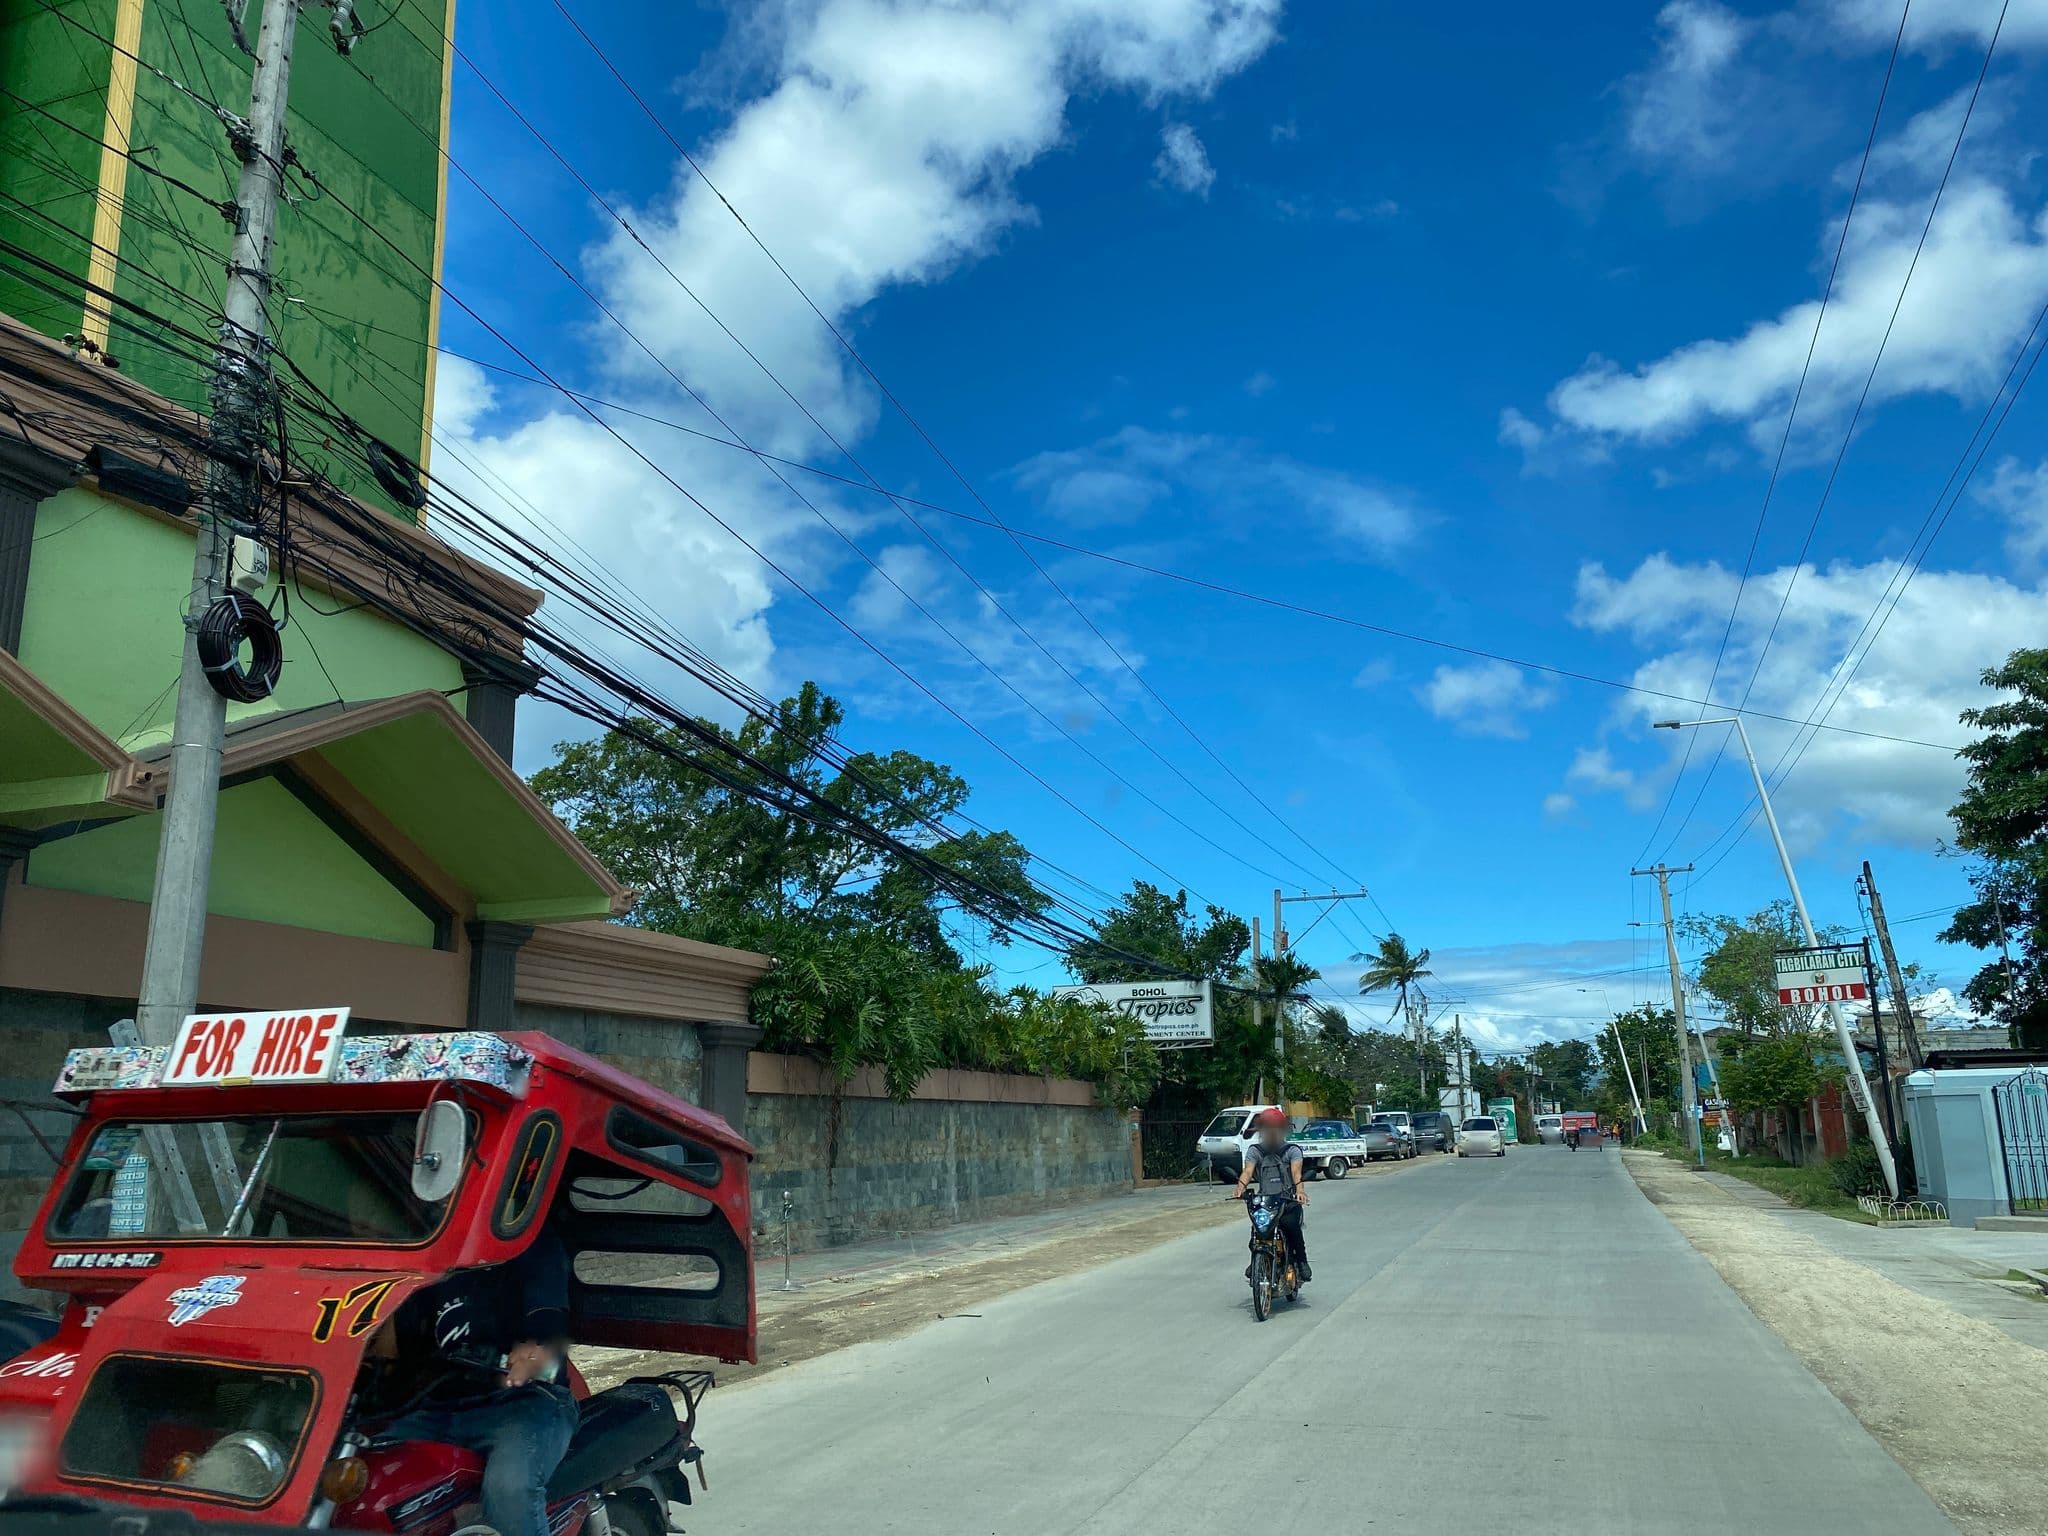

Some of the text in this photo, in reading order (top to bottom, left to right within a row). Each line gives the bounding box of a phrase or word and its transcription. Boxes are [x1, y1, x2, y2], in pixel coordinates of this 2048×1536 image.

[1776, 951, 1860, 973] TAGBILARAN CITY
[1132, 988, 1167, 996] BOHOL
[1790, 985, 1855, 1004] BOHOL
[1117, 995, 1203, 1022] Tropics
[172, 1014, 338, 1078] FOR HIRE
[312, 1276, 410, 1343] 17
